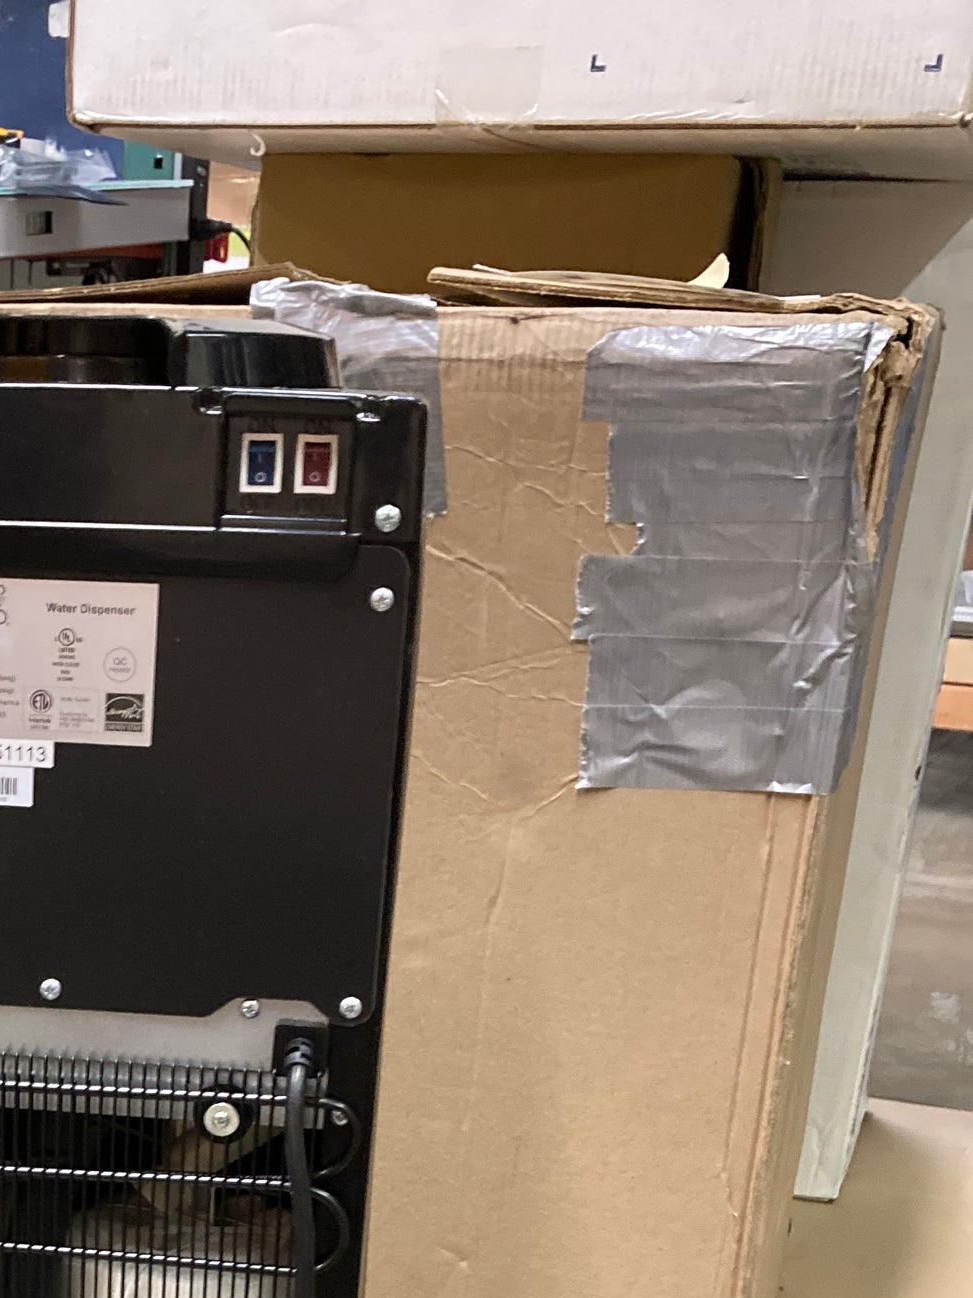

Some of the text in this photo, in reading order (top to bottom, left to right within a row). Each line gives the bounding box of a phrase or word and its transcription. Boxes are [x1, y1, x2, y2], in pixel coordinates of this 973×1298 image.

[46, 603, 136, 616] Water Dispenser
[113, 656, 127, 666] QC
